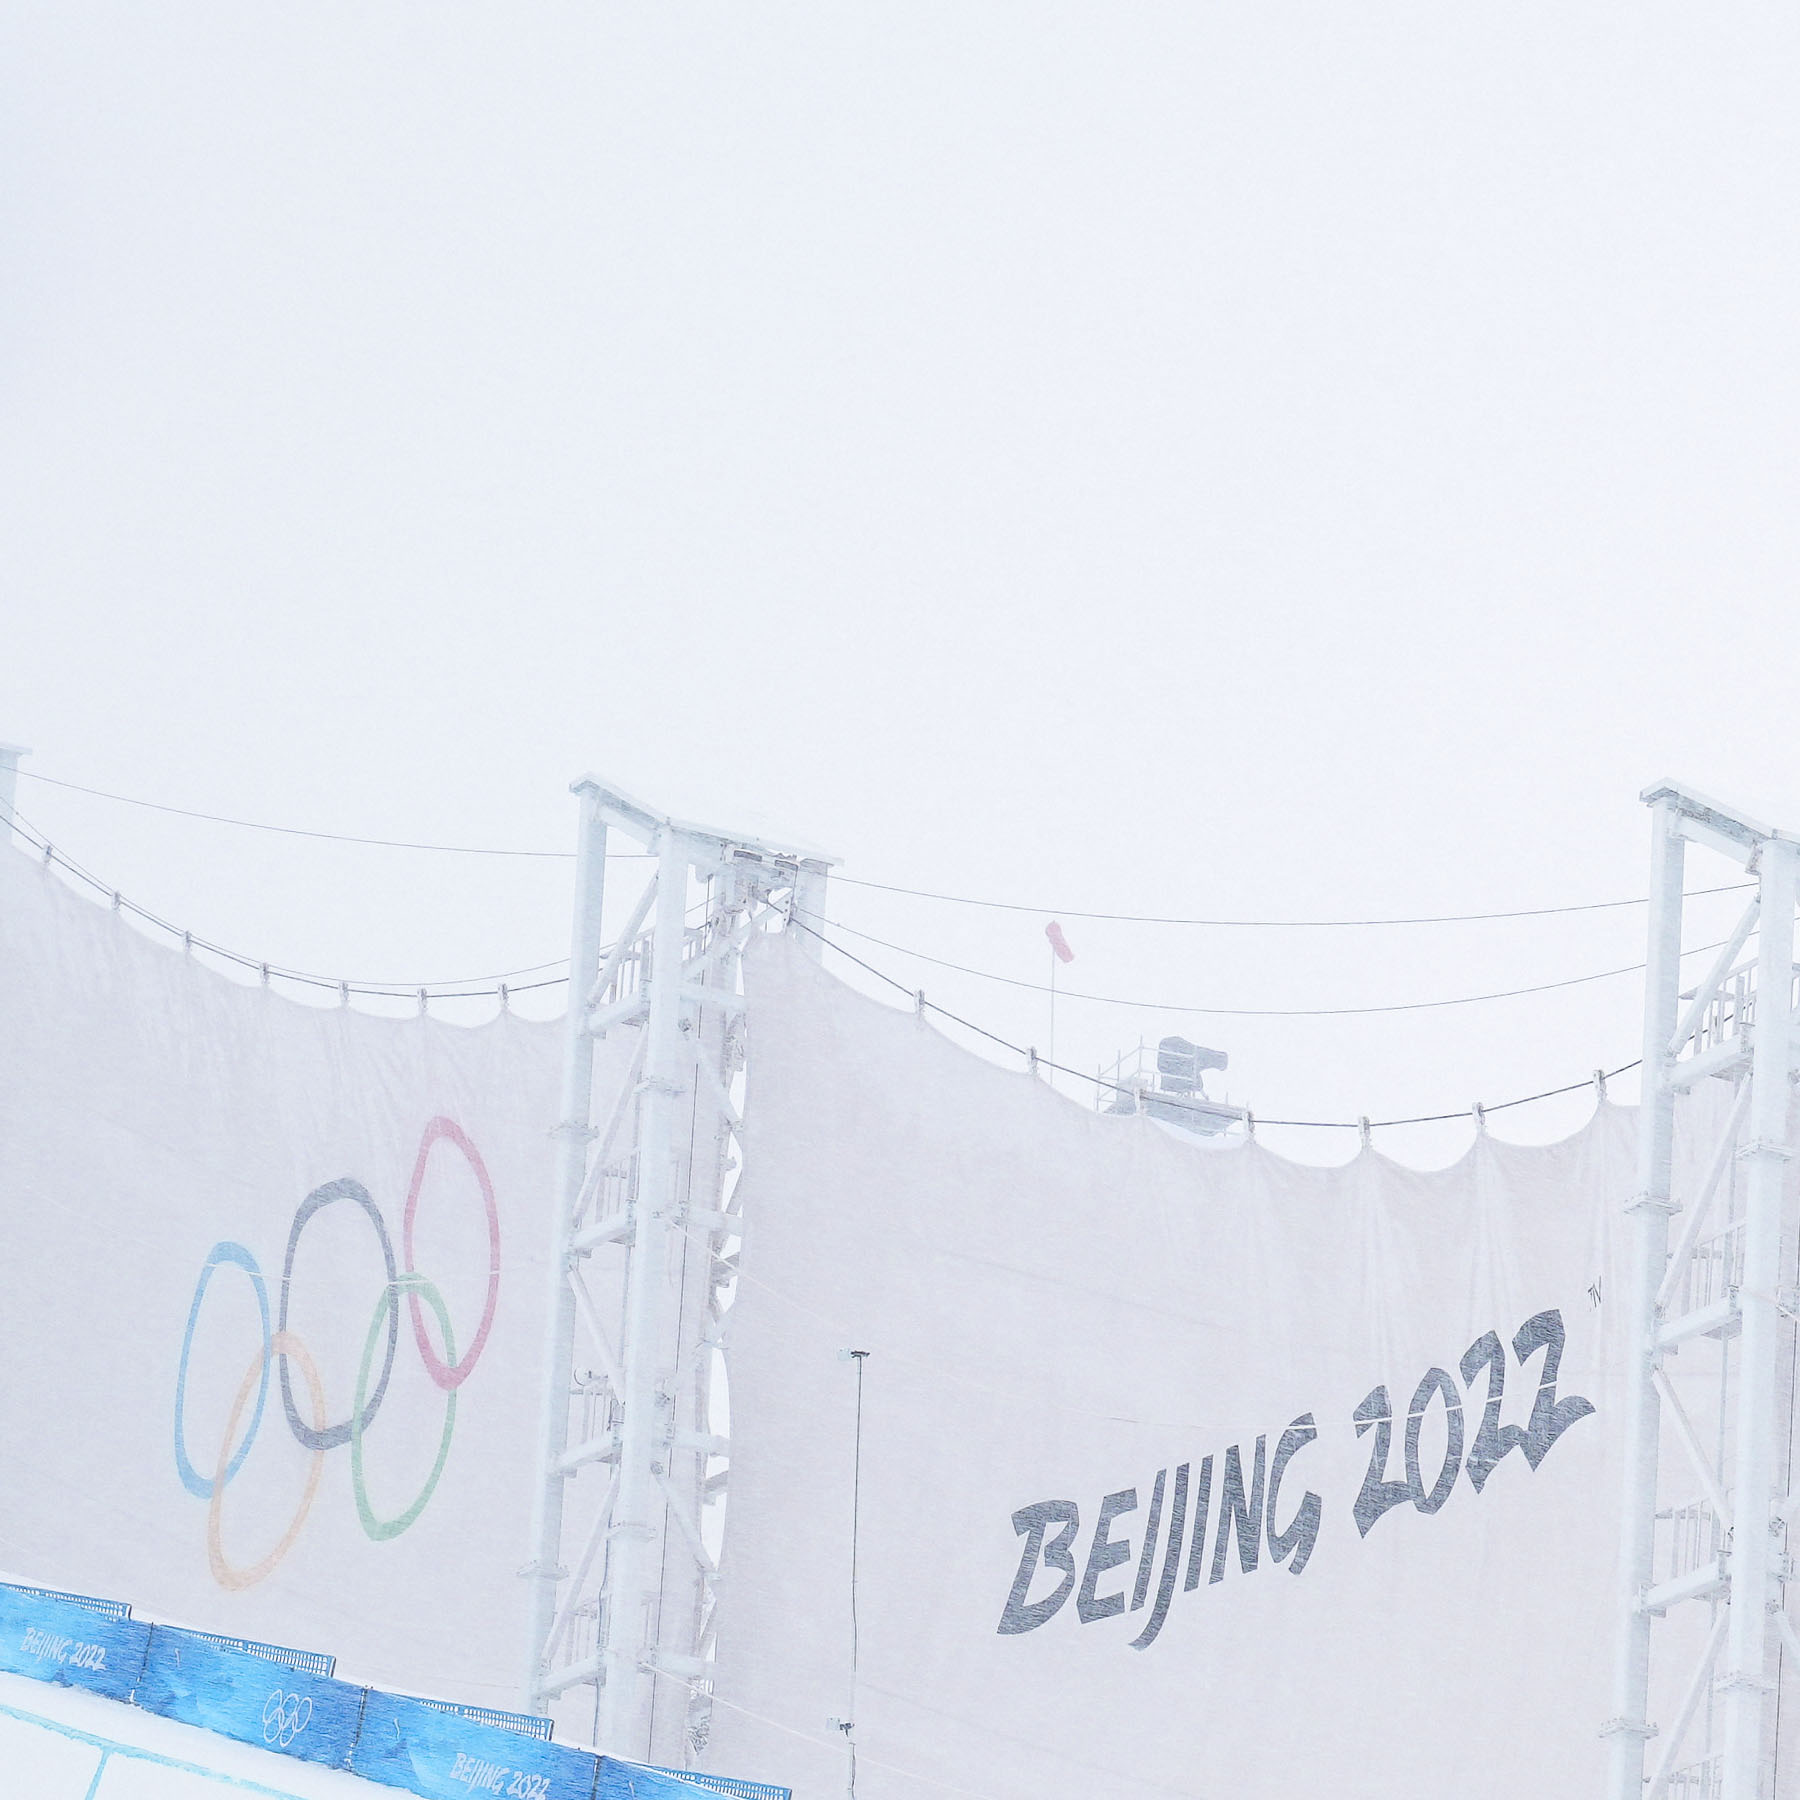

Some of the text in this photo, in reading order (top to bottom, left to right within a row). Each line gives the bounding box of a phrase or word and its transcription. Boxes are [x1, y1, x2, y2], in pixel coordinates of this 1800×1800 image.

[997, 1411, 1323, 1651] BEIJING
[1351, 1307, 1596, 1538] 2022
[20, 1627, 107, 1671] BEIJING 2022
[449, 1752, 511, 1795] BEIJING
